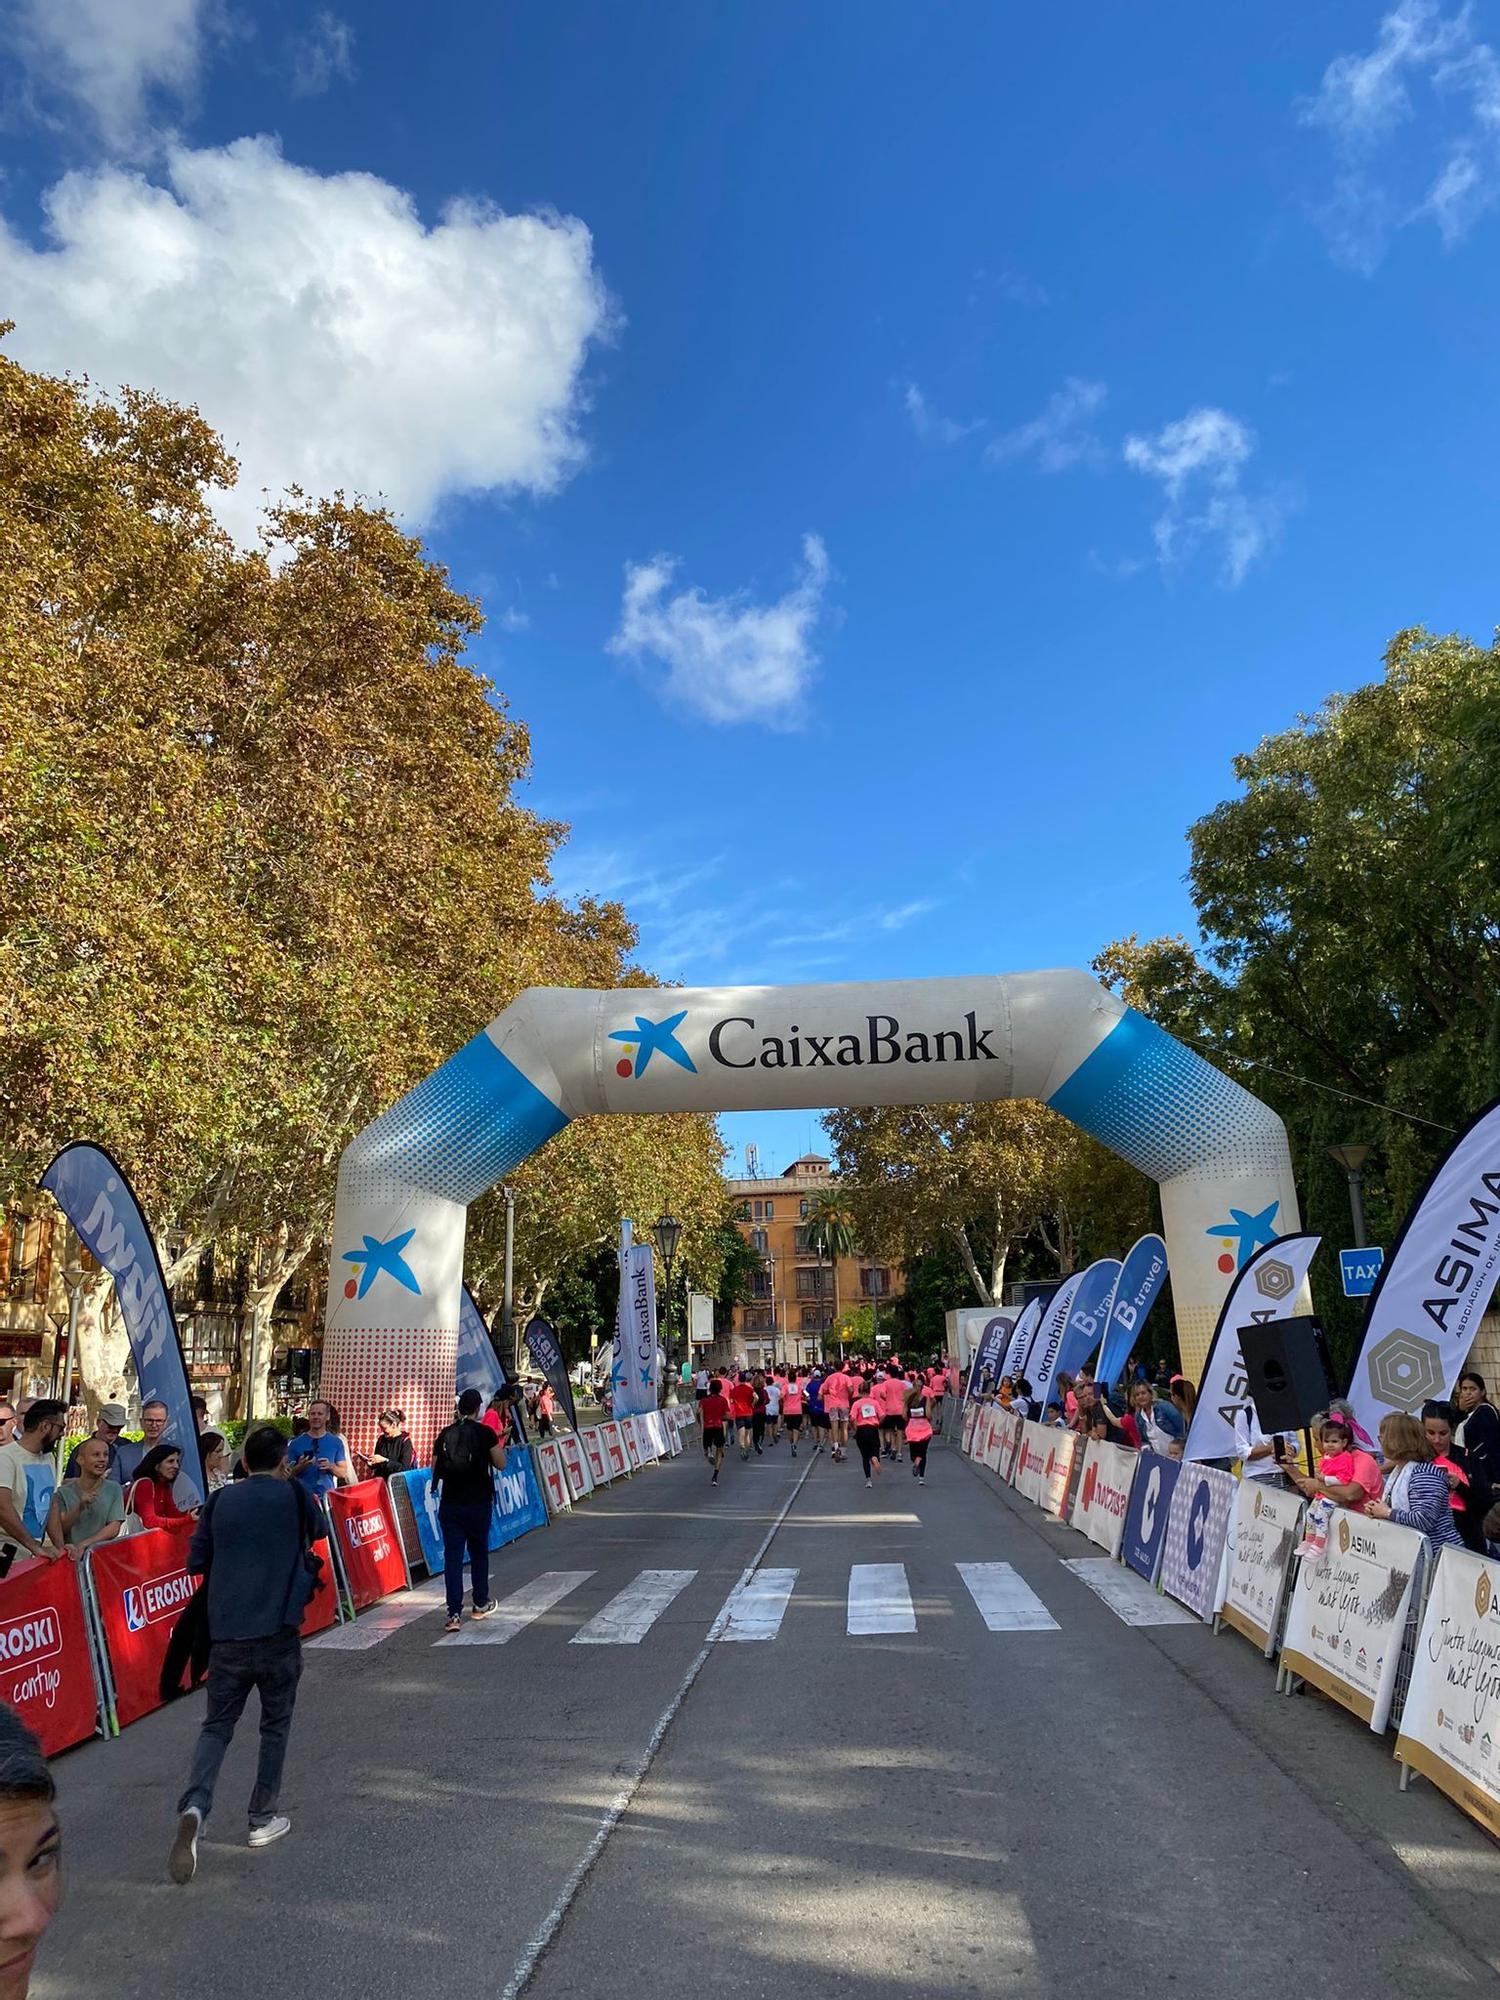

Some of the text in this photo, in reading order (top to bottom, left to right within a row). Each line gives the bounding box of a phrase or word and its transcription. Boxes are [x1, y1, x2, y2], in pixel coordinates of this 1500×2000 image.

[708, 1011, 999, 1068] CaixaBank
[1422, 1173, 1500, 1333] ASIMA
[1485, 1253, 1497, 1270] DE
[631, 1267, 651, 1361] CaixaBank
[1113, 1255, 1164, 1331] B travel
[1070, 1310, 1098, 1337] B
[1217, 1309, 1277, 1429] ASIA
[357, 1514, 384, 1538] EROSKI
[1350, 1534, 1377, 1559] ASIMA
[145, 1574, 193, 1613] EROSKI
[1490, 1595, 1500, 1616] A
[0, 1616, 54, 1660] ROSKI
[13, 1663, 60, 1708] contigo
